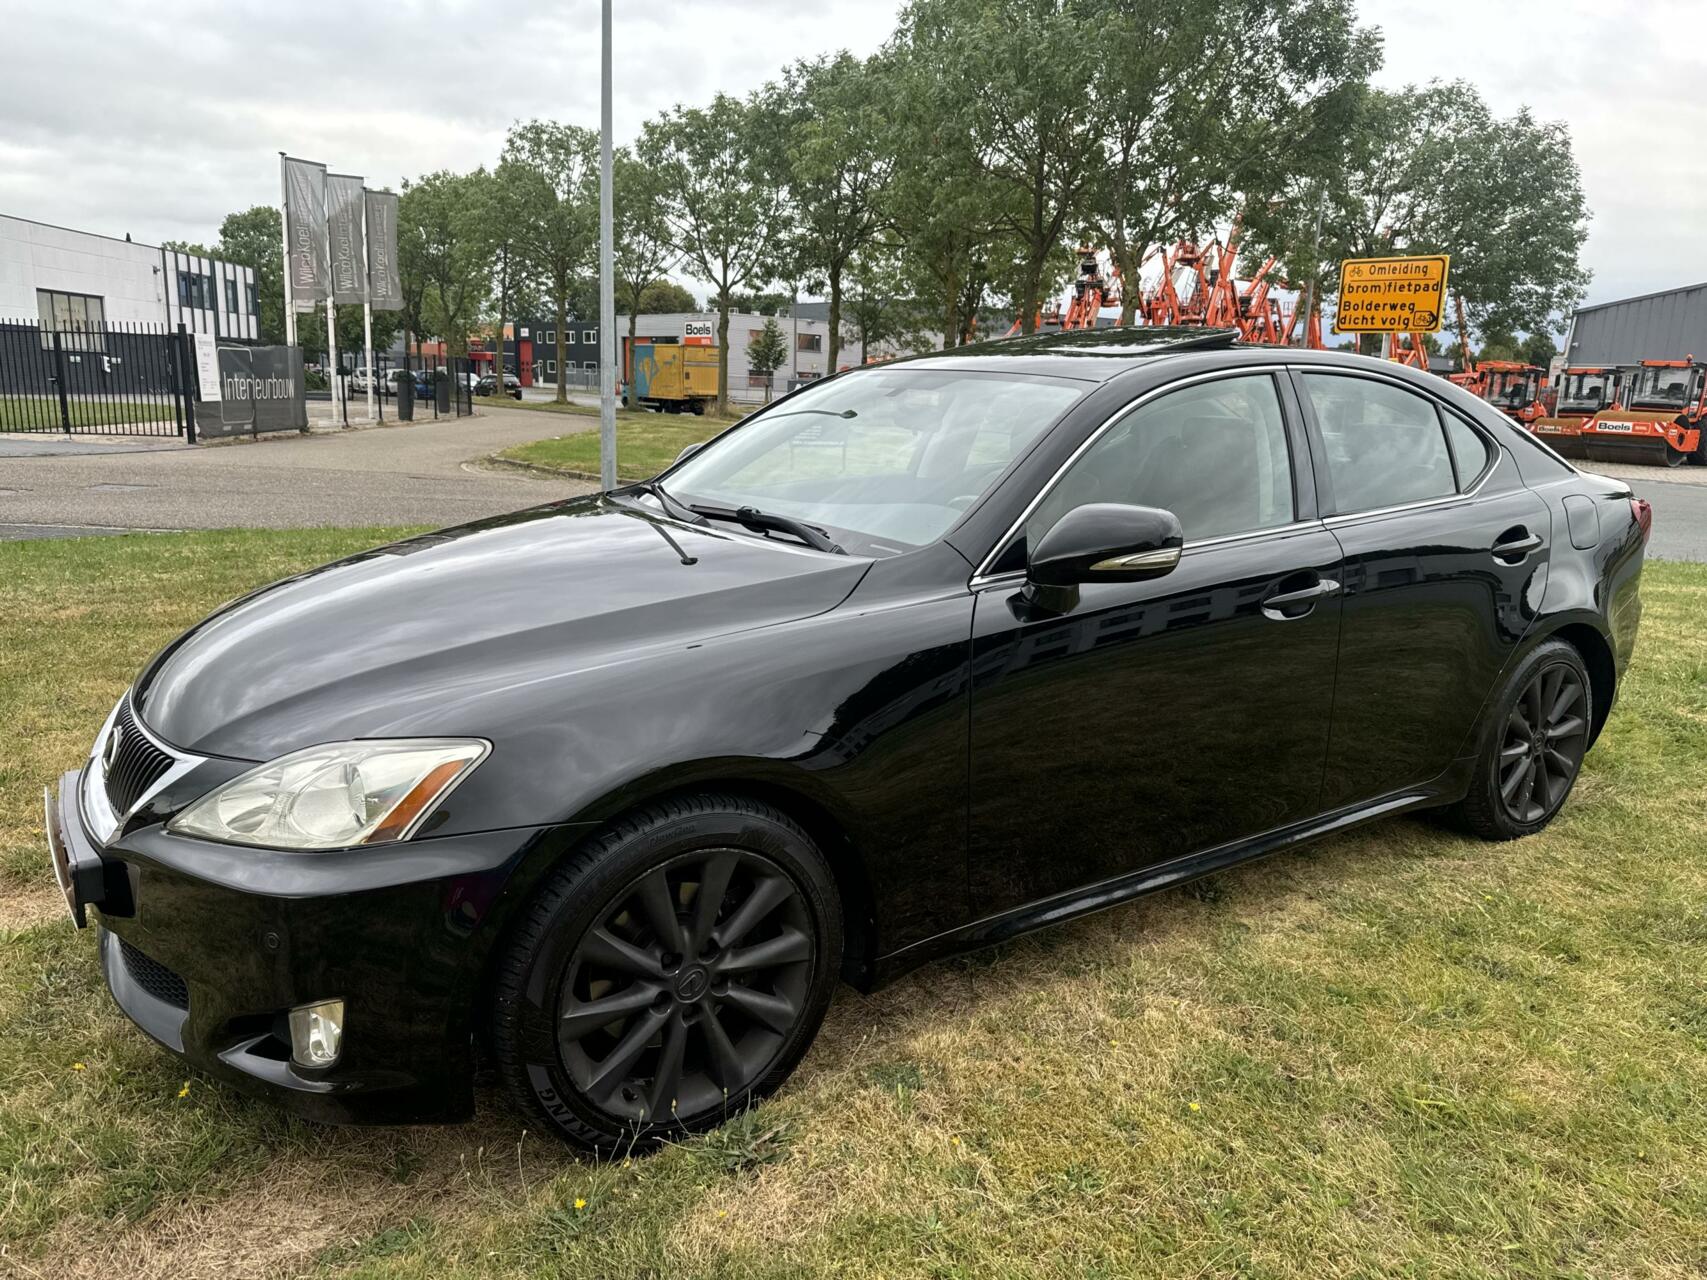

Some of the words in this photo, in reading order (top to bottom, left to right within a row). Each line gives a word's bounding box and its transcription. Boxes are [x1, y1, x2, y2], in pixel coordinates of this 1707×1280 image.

[1369, 263, 1428, 276] Omleiding
[1343, 281, 1440, 295] (brom)fietpad
[1343, 300, 1416, 314] Bolderweg
[1340, 314, 1376, 325] dicht
[1381, 315, 1410, 329] volg
[686, 323, 711, 335] Boels
[223, 371, 295, 401] Interieurbouw
[1598, 422, 1631, 431] Boels
[538, 1088, 608, 1142] IKING
